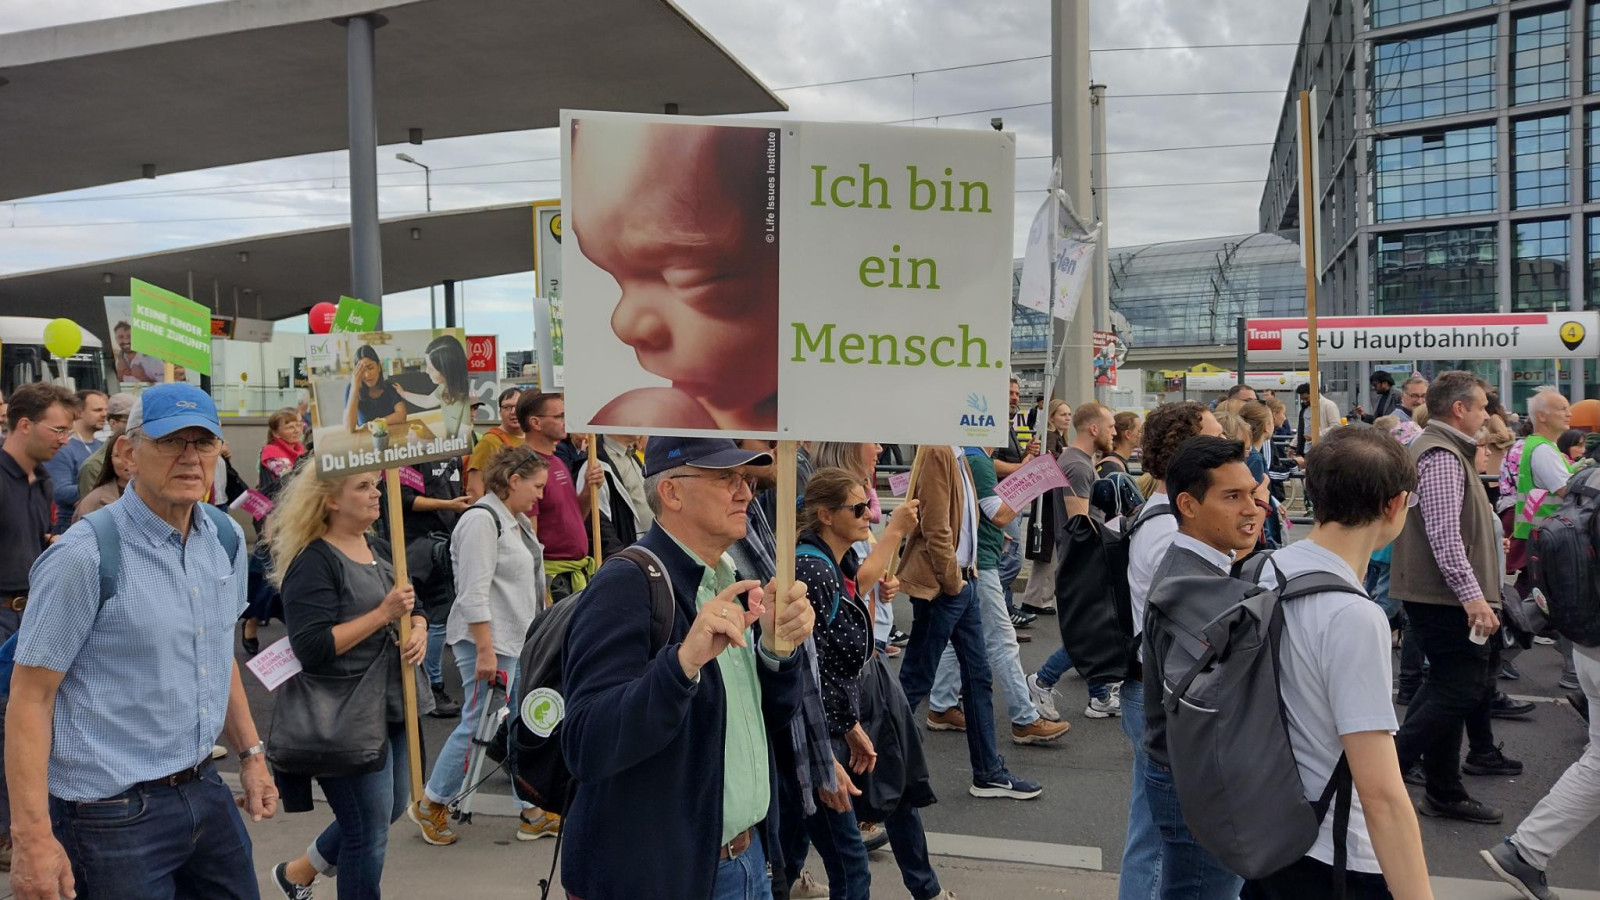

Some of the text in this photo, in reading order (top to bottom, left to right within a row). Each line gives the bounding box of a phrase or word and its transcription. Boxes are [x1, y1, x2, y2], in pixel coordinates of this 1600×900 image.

[766, 131, 776, 174] Institute
[766, 176, 775, 210] Issues
[810, 163, 993, 214] Ich bin
[765, 212, 775, 232] Life
[859, 245, 941, 290] ein
[136, 304, 168, 324] KEINE
[169, 316, 202, 337] KINDER
[1567, 326, 1576, 338] 4
[132, 317, 165, 336] KEINE
[166, 328, 210, 354] ZUKUNFT!
[790, 322, 1004, 369] Mensch.
[1248, 328, 1281, 340] Tram
[1353, 326, 1520, 354] Hauptbahnhof
[470, 360, 486, 368] SOS
[960, 414, 996, 427] ALfA
[321, 433, 469, 473] Du bist nicht allein!
[999, 476, 1018, 493] LEBEN
[1002, 478, 1027, 498] BEGINNT
[253, 650, 275, 668] LEBEN
[257, 651, 285, 673] BEGINNT
